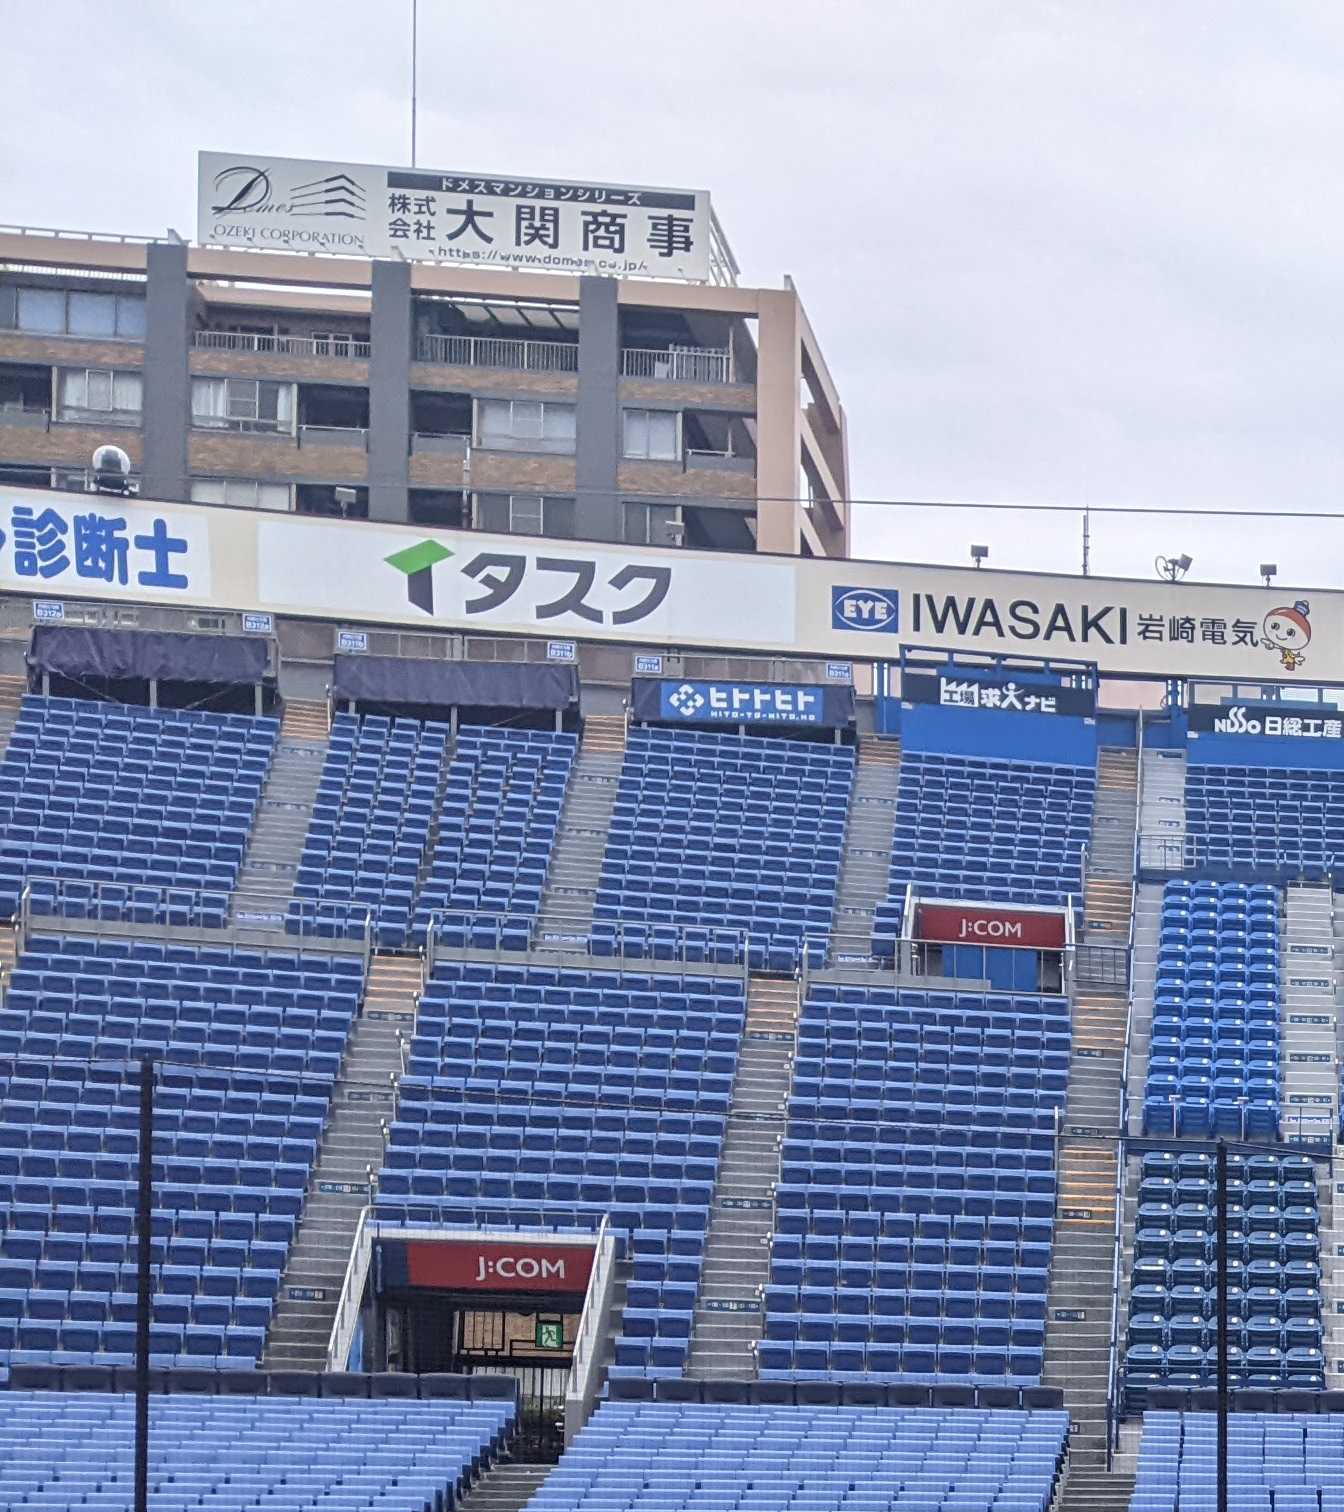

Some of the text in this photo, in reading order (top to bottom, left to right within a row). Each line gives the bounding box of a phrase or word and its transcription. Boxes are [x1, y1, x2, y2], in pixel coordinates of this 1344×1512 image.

[441, 176, 641, 206] ドメスマンションシリーズ
[213, 223, 366, 246] OZEKI CORPORATION
[446, 199, 694, 258] 大関商事
[0, 506, 190, 590] 診断士
[459, 552, 672, 626] タスク
[843, 599, 888, 621] EYE
[911, 592, 1260, 649] IWASAKI 岩崎電気
[1264, 716, 1342, 739] 日総工産
[958, 918, 1022, 938] J:COM
[475, 1255, 566, 1281] J:COM
